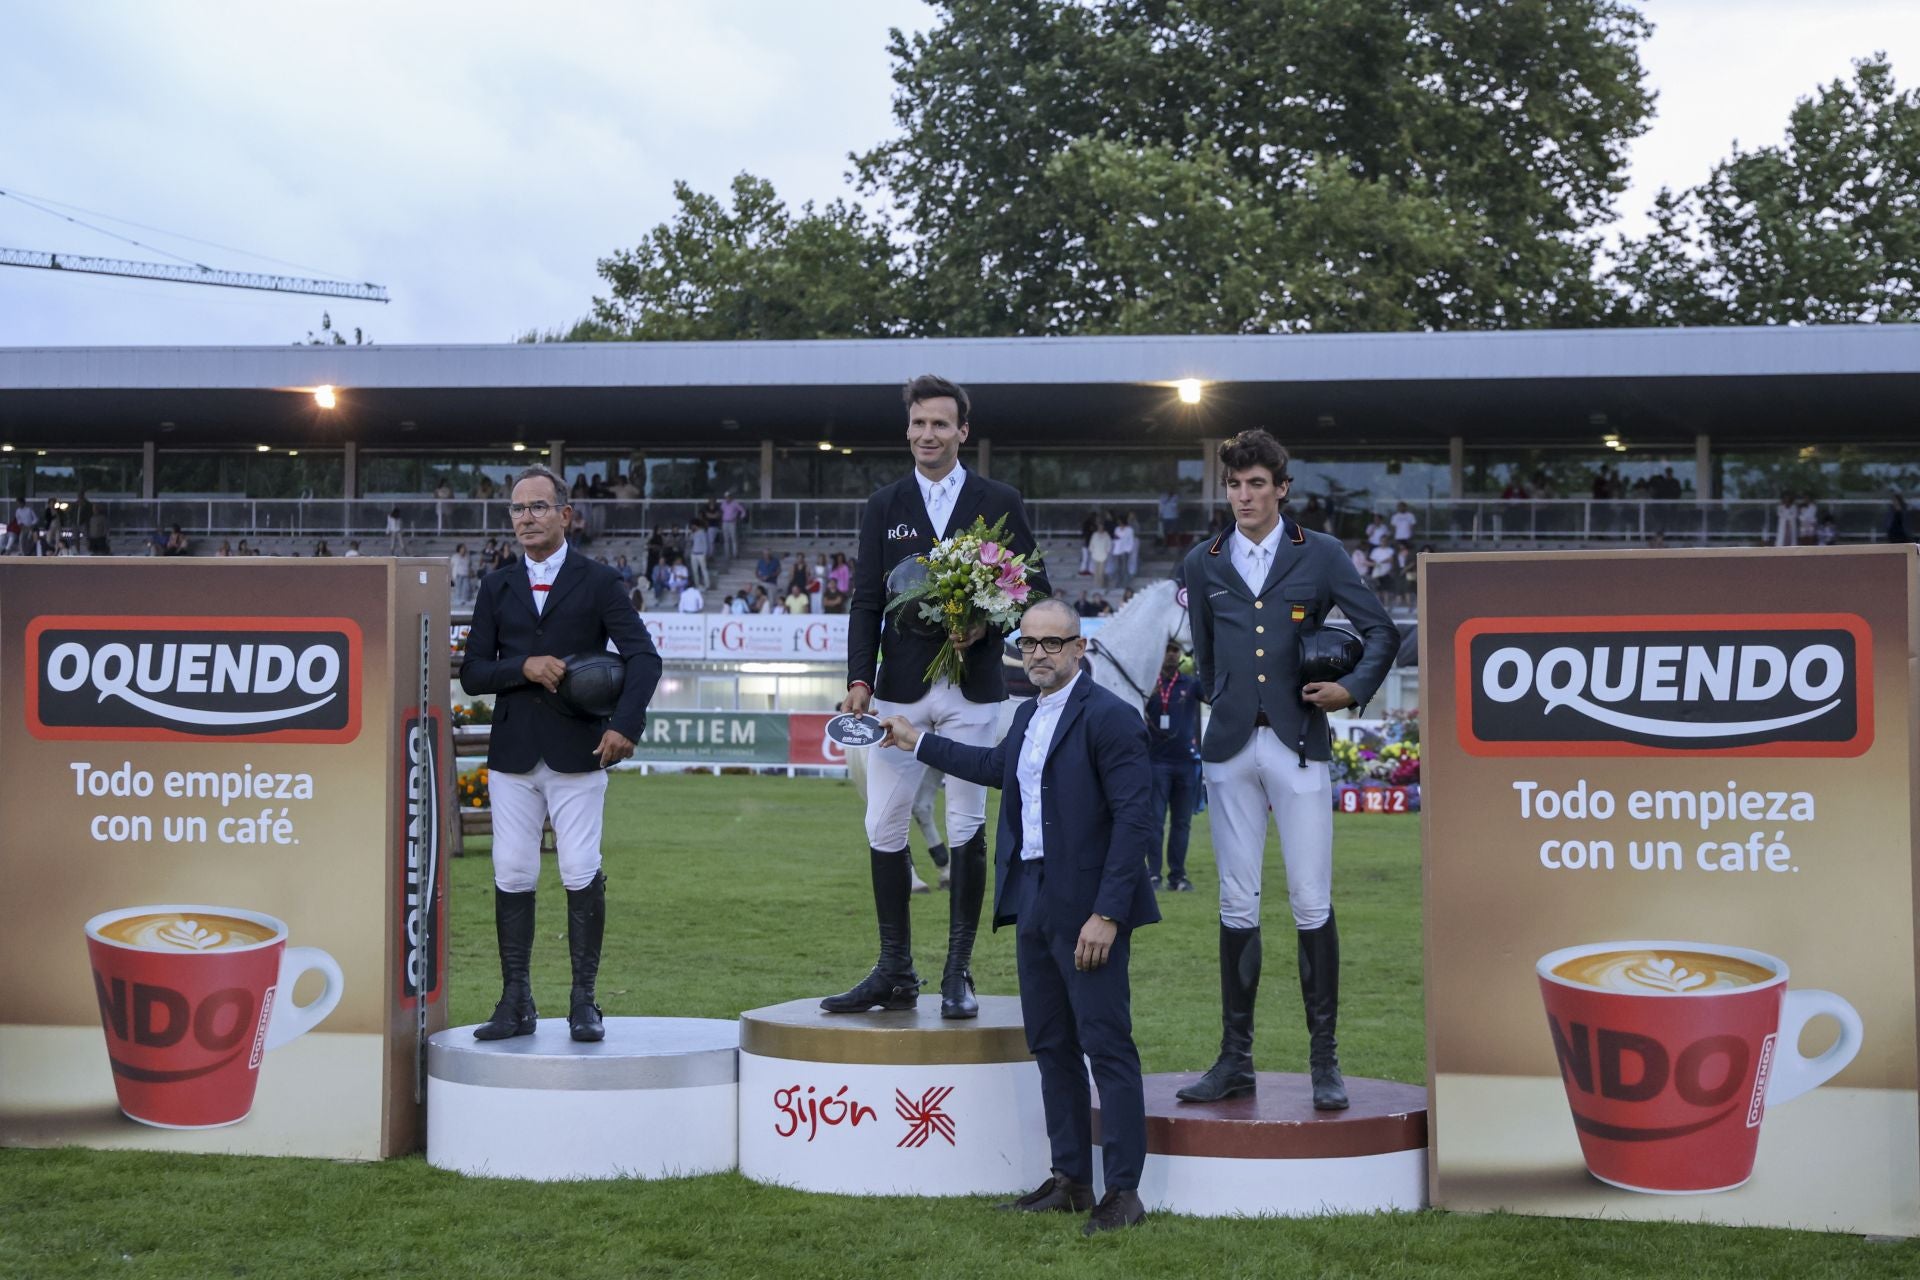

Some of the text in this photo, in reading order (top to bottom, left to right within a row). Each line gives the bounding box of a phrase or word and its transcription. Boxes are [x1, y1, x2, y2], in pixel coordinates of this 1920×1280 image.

[888, 524, 918, 540] RGA
[47, 642, 340, 725] OQUENDO
[1482, 645, 1844, 737] OQUENDO
[70, 762, 313, 807] Todo empieza
[1344, 791, 1357, 812] 9
[1366, 791, 1382, 810] 12
[1393, 791, 1405, 811] 2
[1512, 779, 1815, 830] Todo empieza
[91, 807, 299, 845] con un café.
[1540, 830, 1799, 873] con un café.
[252, 991, 273, 1063] OQUENDO
[1751, 1041, 1773, 1121] OQUENDO
[774, 1084, 877, 1143] gijón
